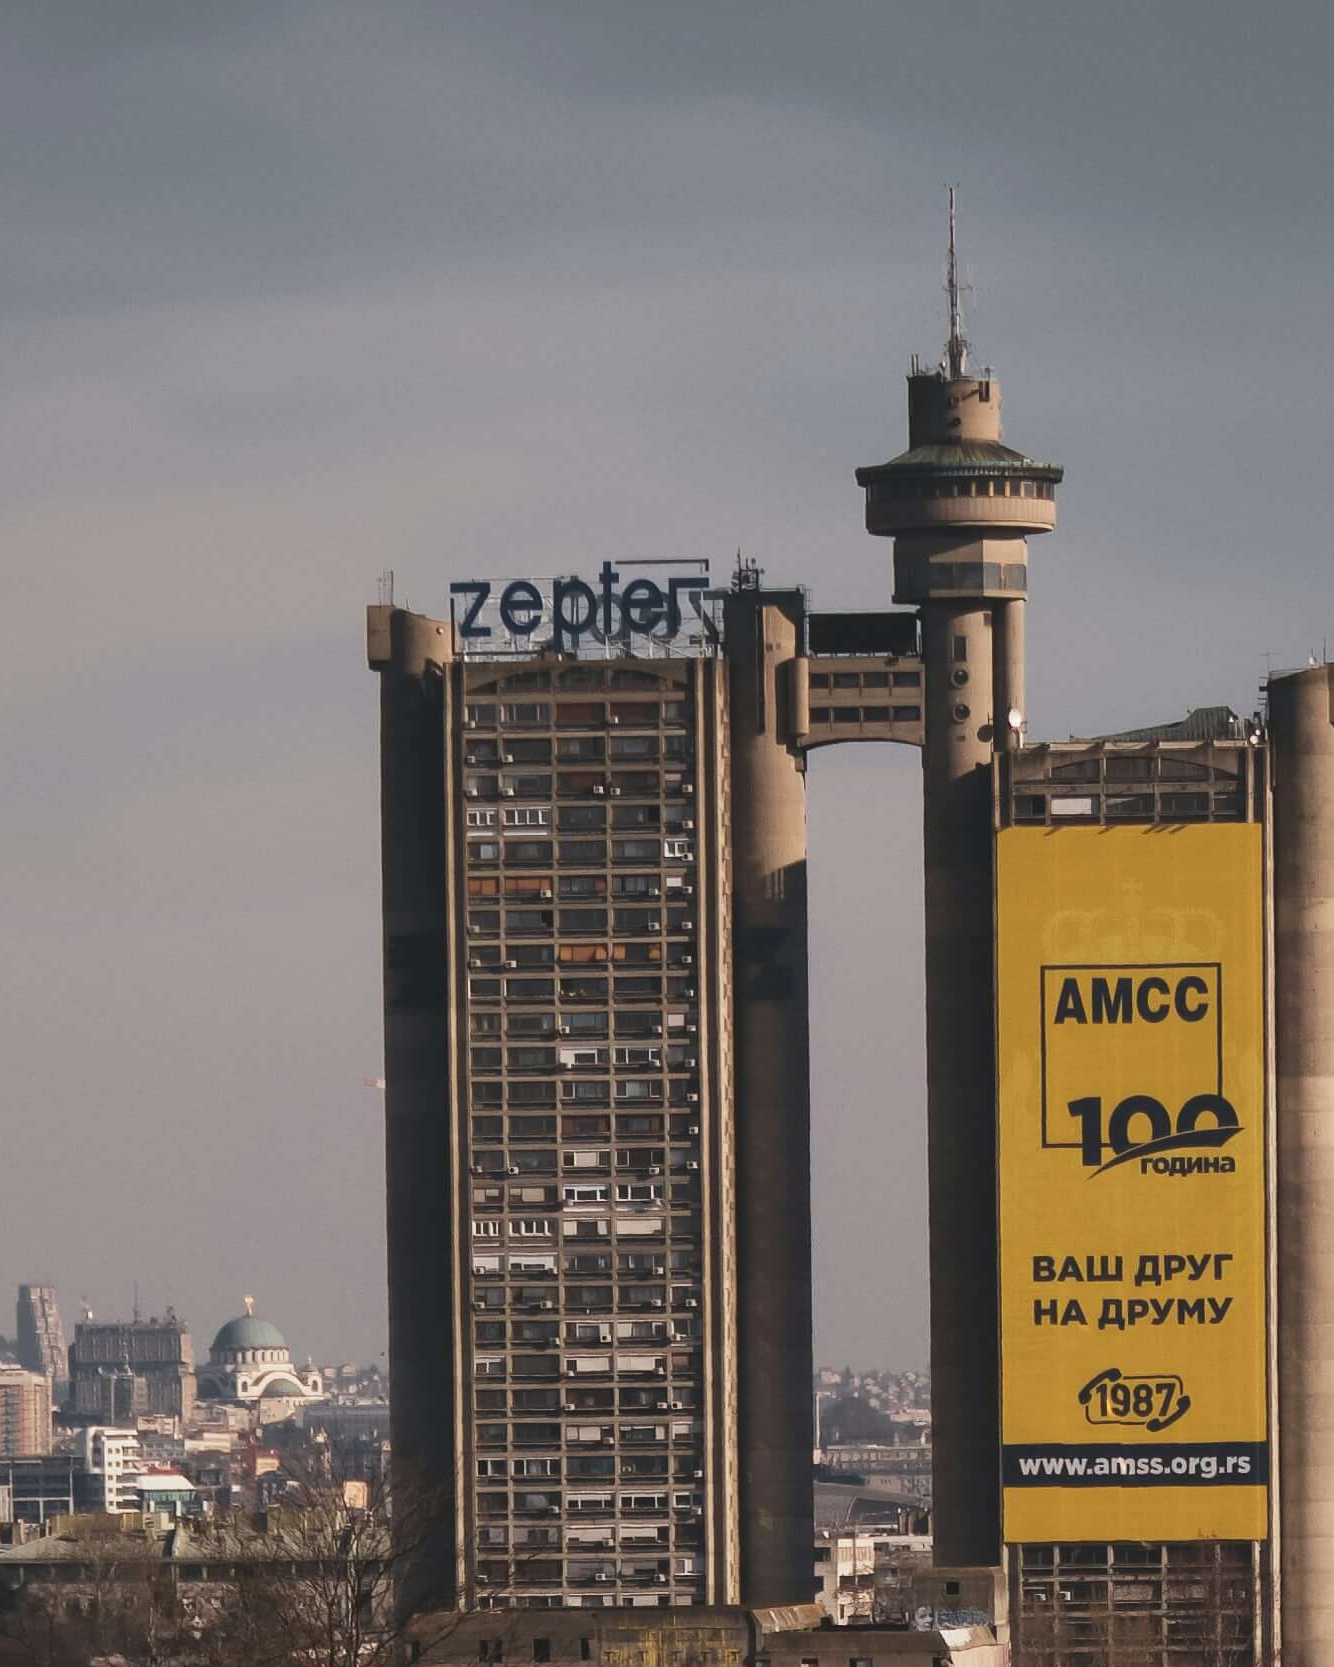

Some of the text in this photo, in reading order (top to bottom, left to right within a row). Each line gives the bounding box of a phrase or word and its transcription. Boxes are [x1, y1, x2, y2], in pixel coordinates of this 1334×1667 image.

[450, 561, 709, 654] zepter
[1054, 975, 1210, 1025] АМСС
[1067, 1093, 1241, 1168] 100
[1139, 1154, 1236, 1179] година
[1032, 1253, 1233, 1287] ВАШ ДРУГ
[1033, 1296, 1233, 1329] НА ДРУМУ
[1095, 1381, 1175, 1418] 1987
[1018, 1453, 1251, 1479] www.amss.org.rs
